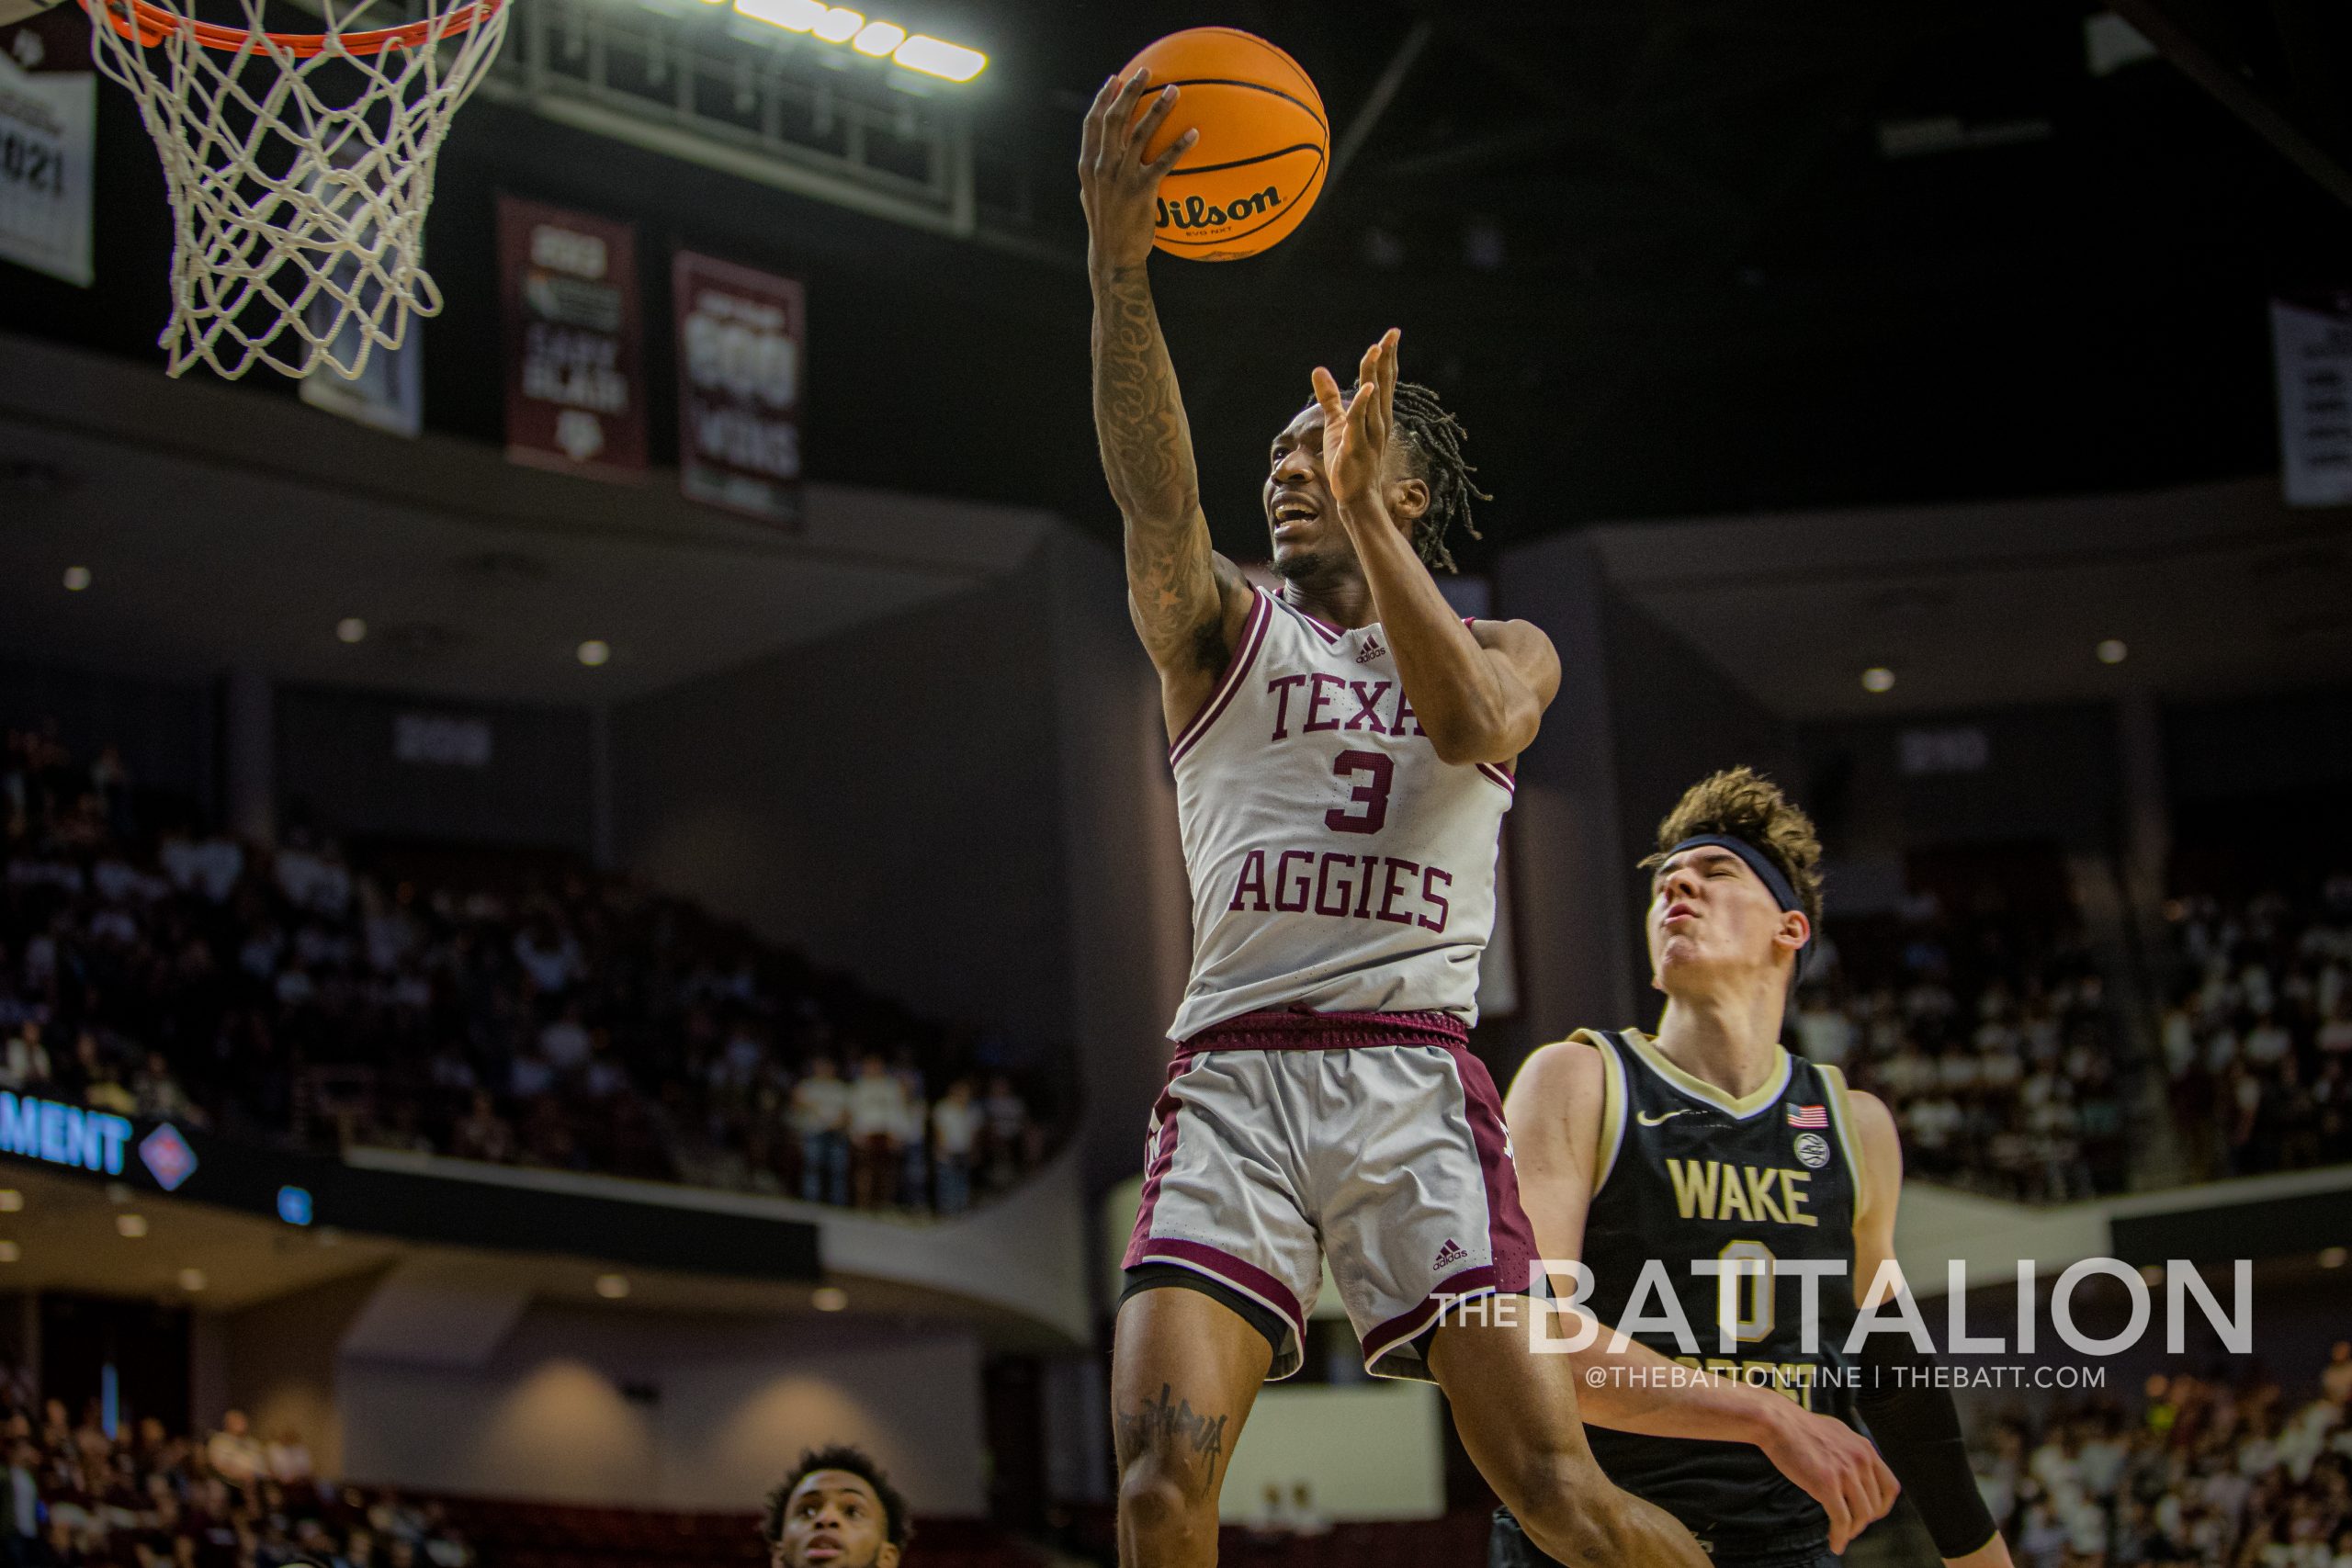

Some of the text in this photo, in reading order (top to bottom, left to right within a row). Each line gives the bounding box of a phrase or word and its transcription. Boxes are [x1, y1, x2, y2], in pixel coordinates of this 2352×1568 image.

[1355, 645, 1386, 664] adidas
[1267, 672, 1429, 741] TEXA
[1324, 749, 1395, 835] 3
[1228, 850, 1453, 934] AGGIES
[1666, 1159, 1819, 1227] WAKE
[1431, 1247, 1469, 1271] adidas
[1716, 1240, 1776, 1342] 0
